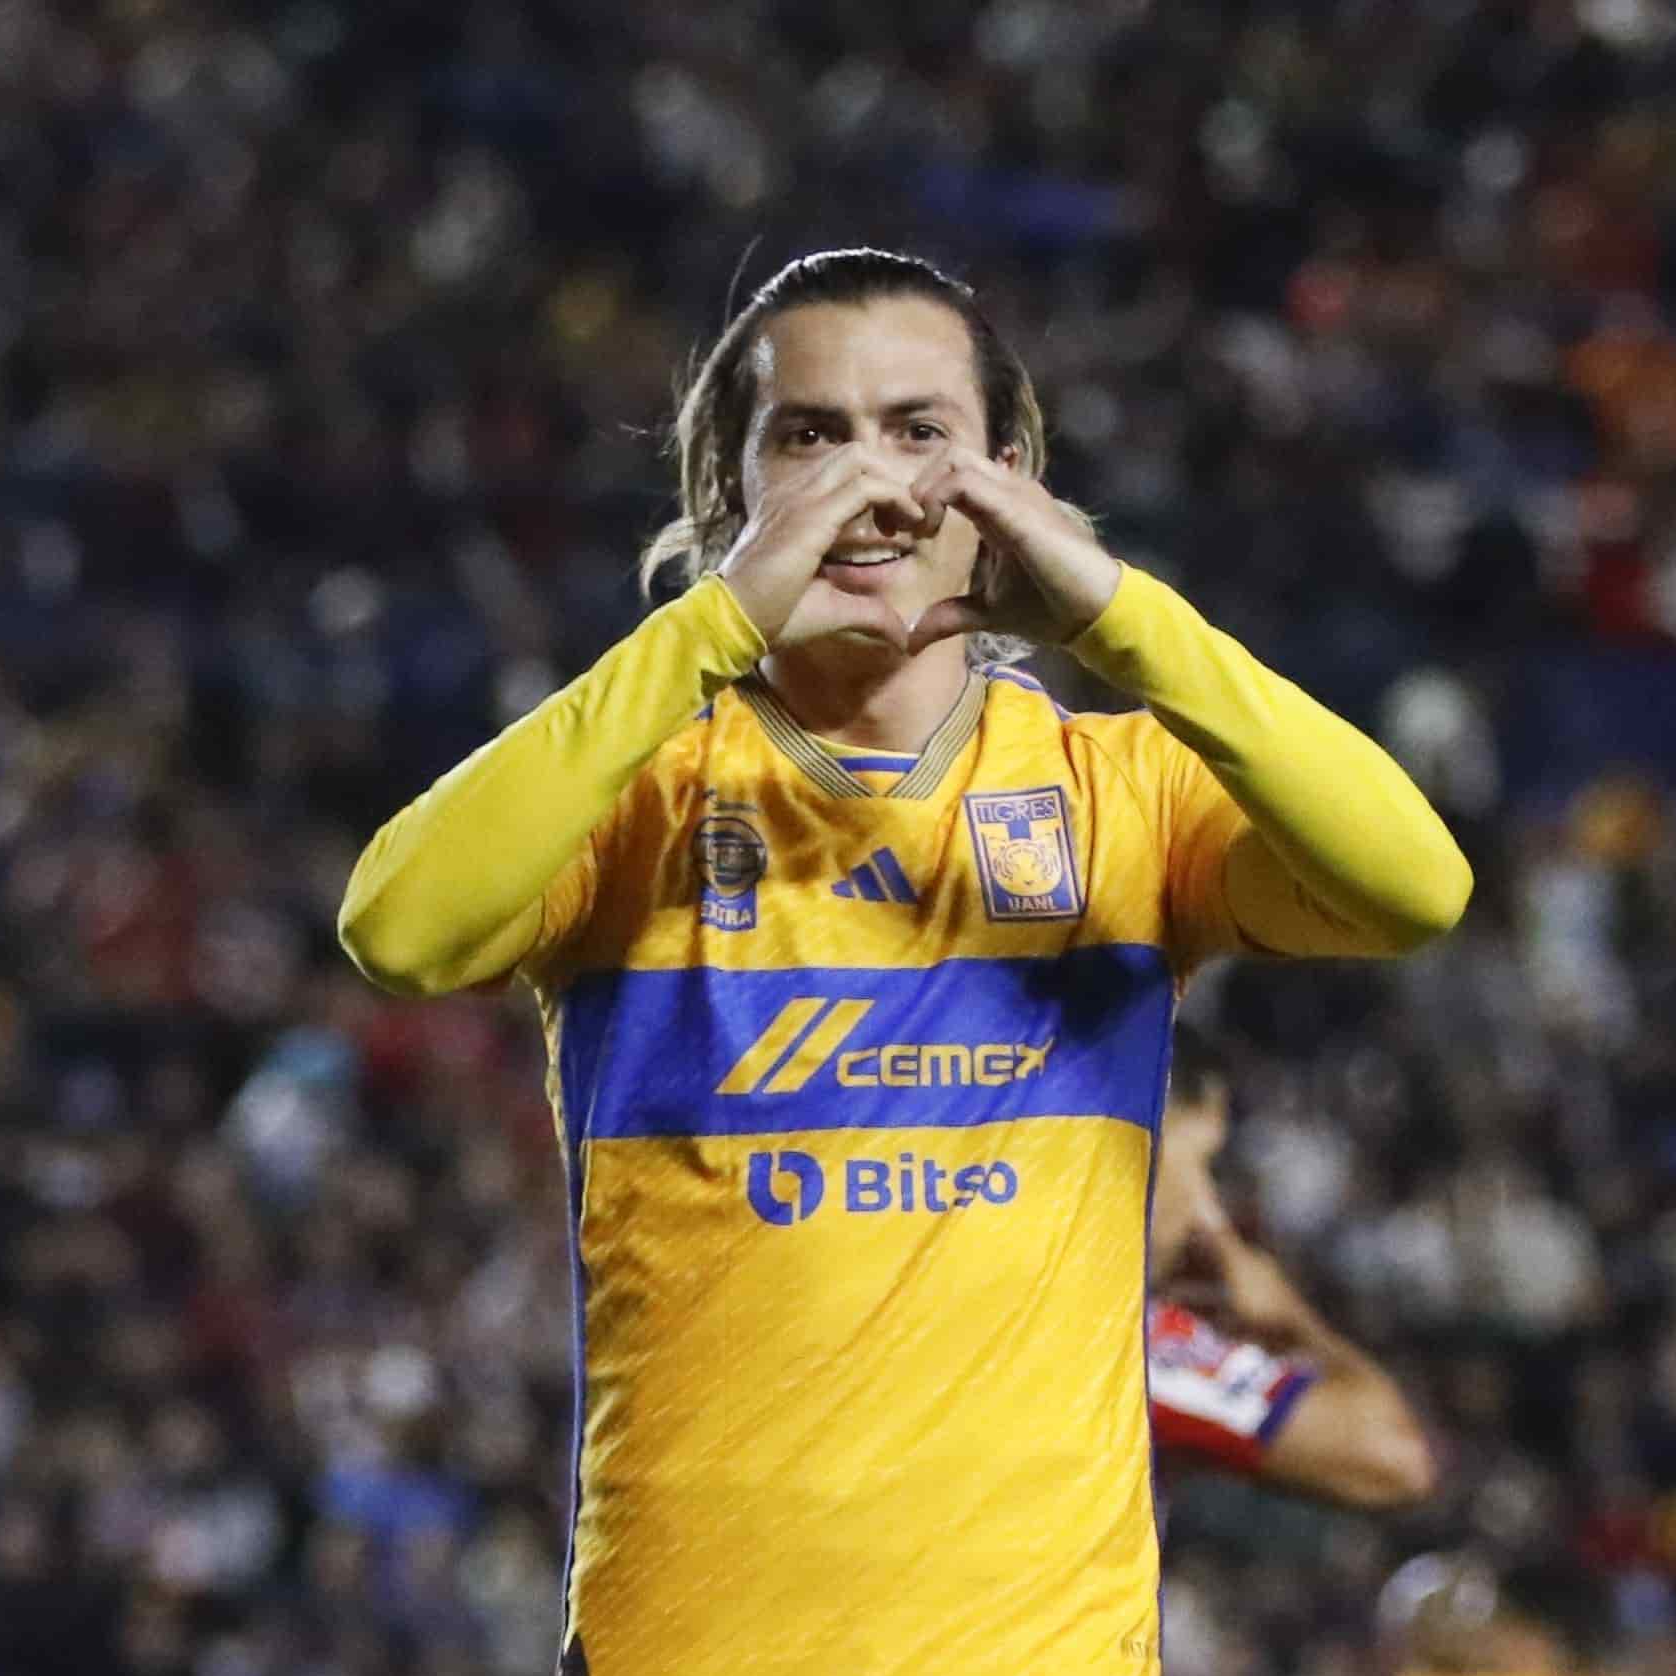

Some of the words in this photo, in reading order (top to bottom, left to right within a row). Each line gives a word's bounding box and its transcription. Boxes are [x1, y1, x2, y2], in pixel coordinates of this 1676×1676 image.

[975, 798, 1056, 823] TIGRES
[836, 1037, 1055, 1088] CEMEX
[845, 1152, 1018, 1214] Bitso
